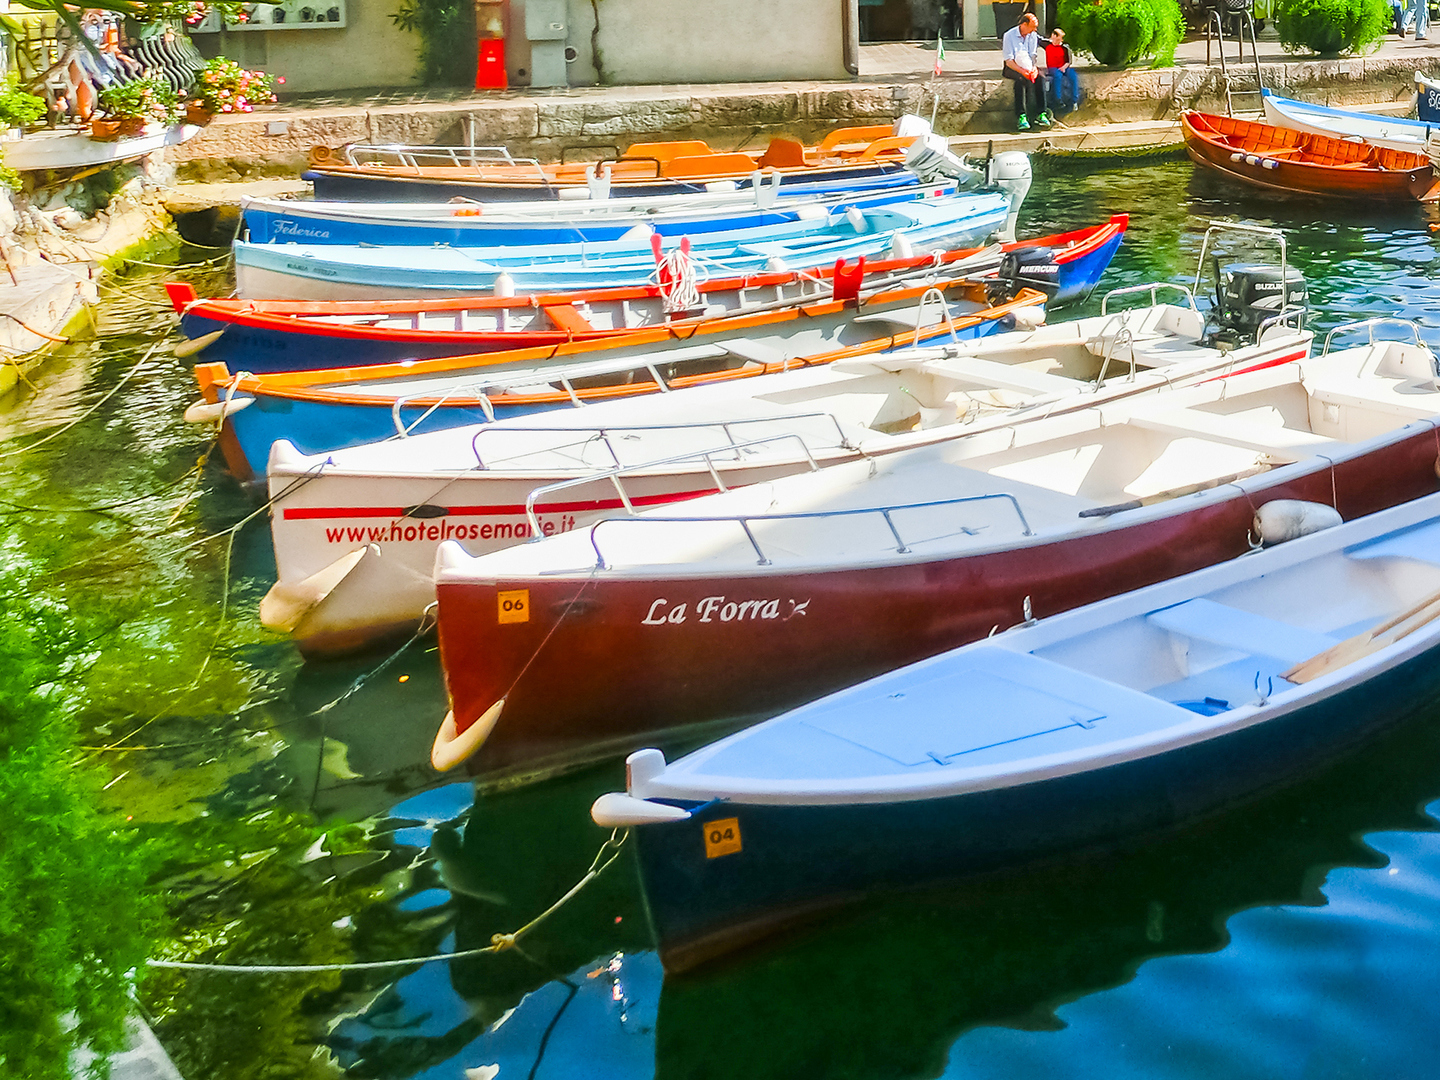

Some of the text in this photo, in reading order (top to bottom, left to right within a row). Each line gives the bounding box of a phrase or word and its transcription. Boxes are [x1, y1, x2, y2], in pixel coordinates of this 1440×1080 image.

[272, 219, 330, 238] Federica
[502, 599, 524, 612] 06
[641, 595, 780, 625] La Forra
[710, 827, 735, 844] 04
